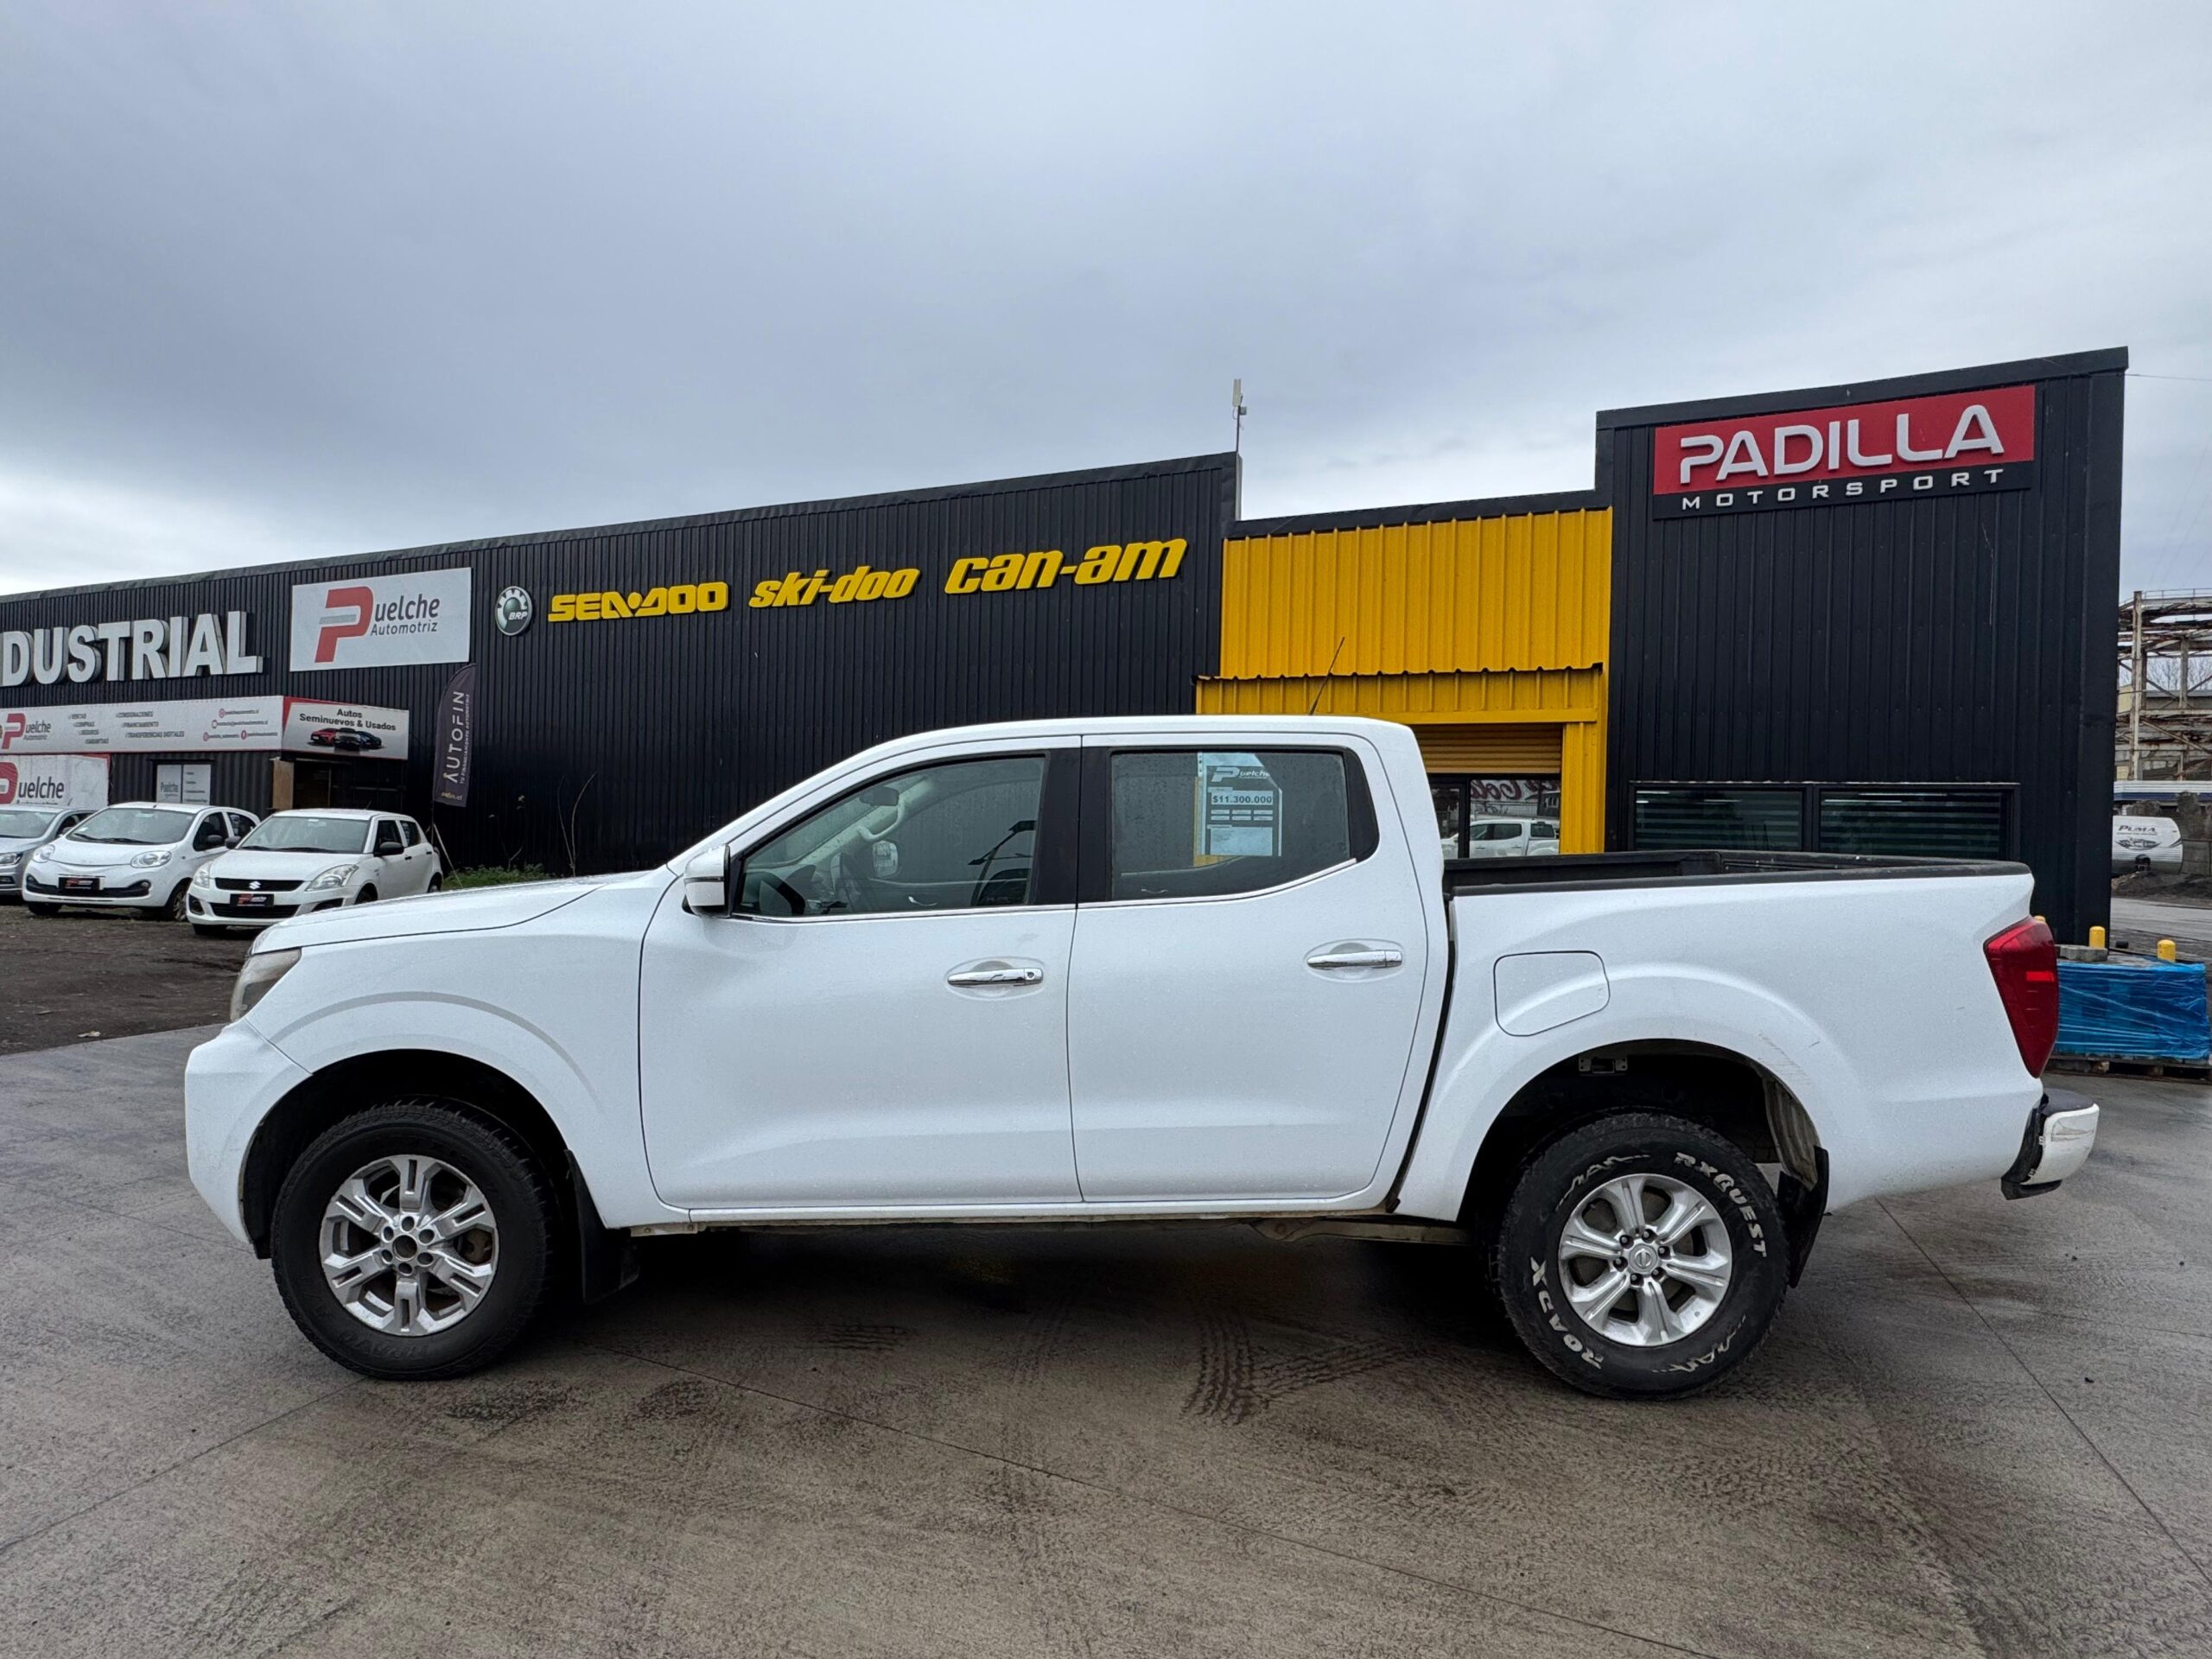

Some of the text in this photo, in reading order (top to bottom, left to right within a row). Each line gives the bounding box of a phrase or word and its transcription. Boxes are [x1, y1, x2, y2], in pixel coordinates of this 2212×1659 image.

[1680, 404, 2005, 484] PADILLA
[1681, 469, 2005, 511] MOTORSPORT
[748, 565, 921, 607] ski-doo
[944, 538, 1187, 594] can-am
[371, 621, 438, 636] Automotriz
[508, 611, 528, 620] BRP
[0, 611, 263, 687] DUSTRIAL
[299, 713, 354, 727] Seminuevos
[365, 721, 397, 730] Usados
[336, 709, 363, 718] Autos
[442, 691, 465, 784] AUTOFIN
[1212, 795, 1273, 804] $11.300.000
[1529, 1256, 1605, 1369] ROADX
